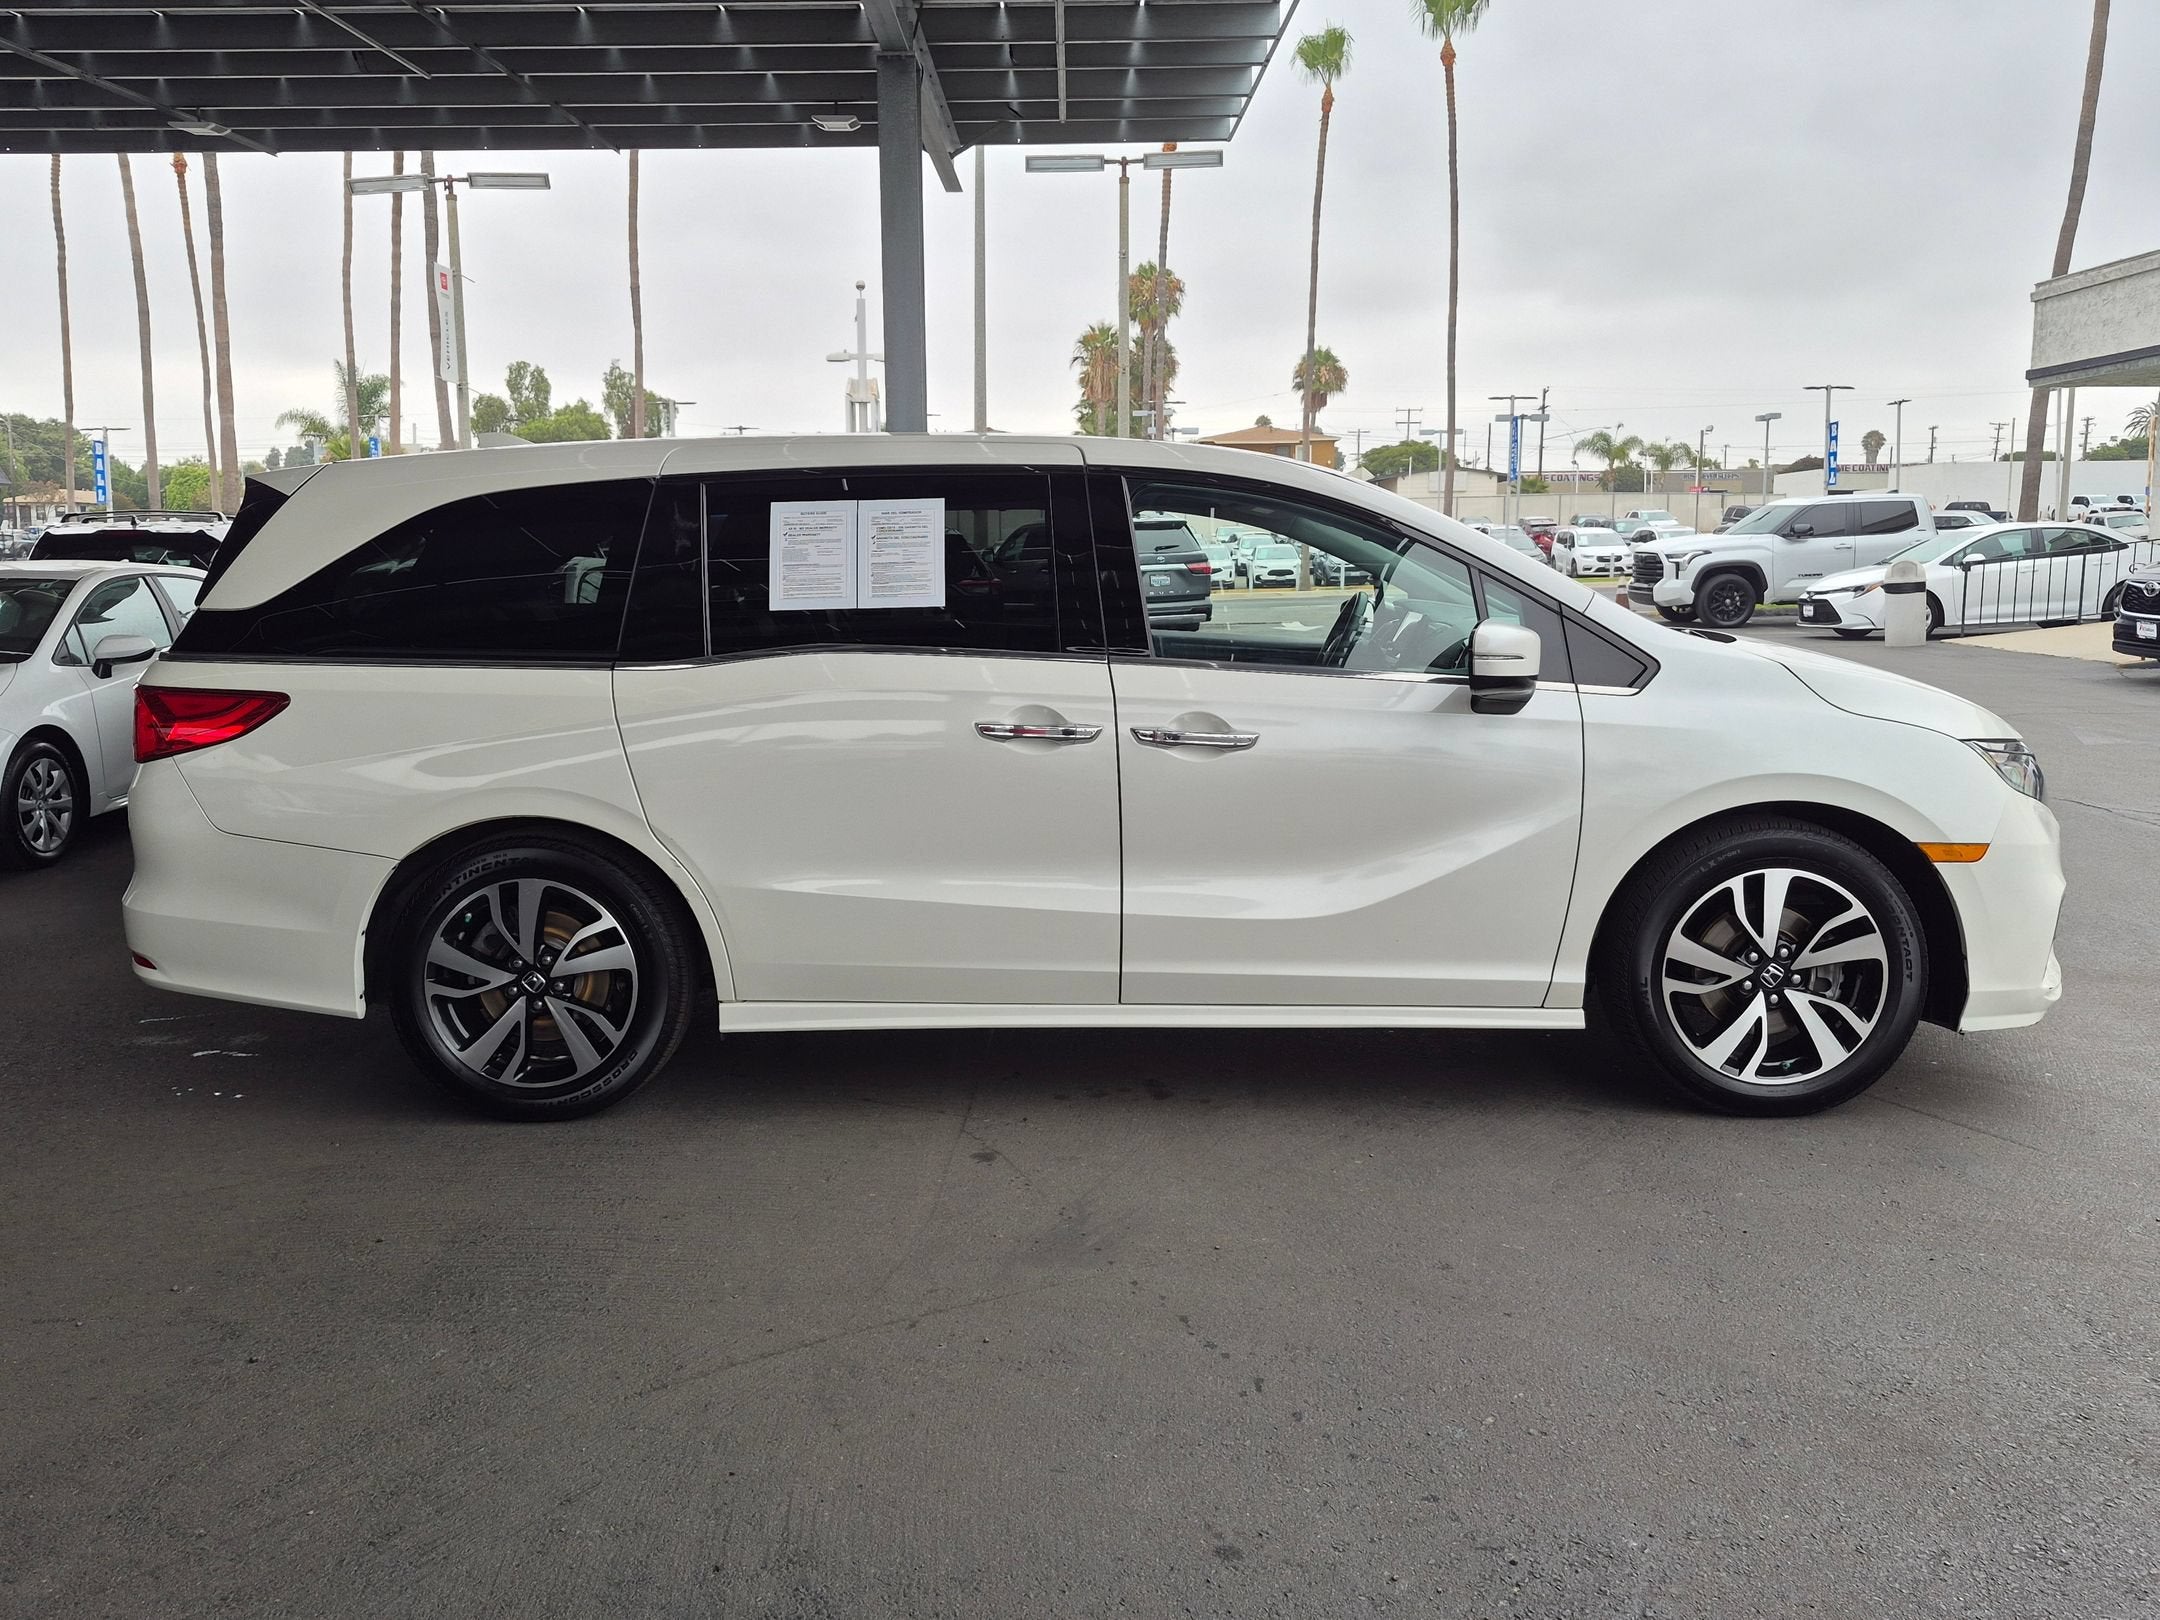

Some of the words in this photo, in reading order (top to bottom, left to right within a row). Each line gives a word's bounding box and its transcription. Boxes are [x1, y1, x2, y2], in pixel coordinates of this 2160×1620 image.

[94, 442, 105, 502] BALL
[1550, 473, 1601, 481] COATNGS
[1828, 423, 1838, 484] BALL
